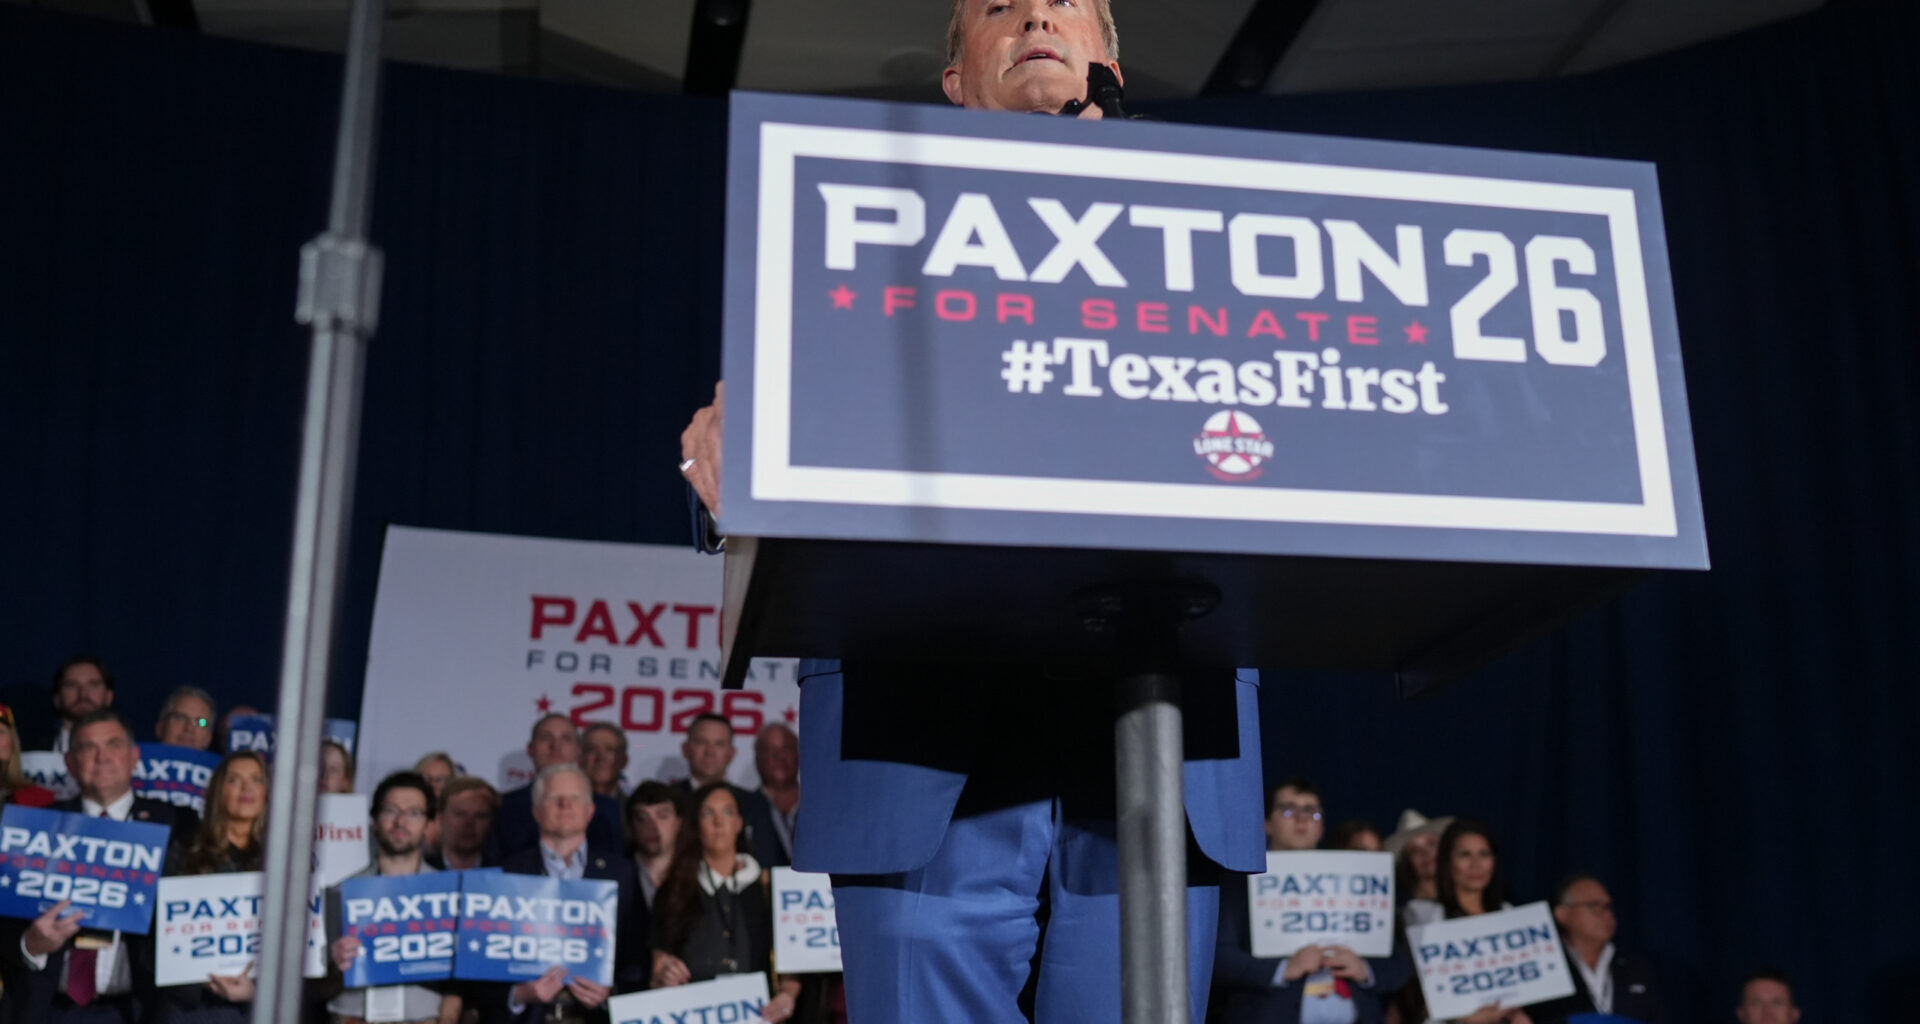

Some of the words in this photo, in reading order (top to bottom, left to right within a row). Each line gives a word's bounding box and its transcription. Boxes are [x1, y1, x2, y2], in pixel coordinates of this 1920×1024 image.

[818, 183, 1429, 306] PAXTON
[1443, 229, 1607, 367] 26
[883, 287, 1034, 325] FOR
[1081, 299, 1379, 345] SENATE
[1001, 337, 1448, 415] #TexasFirst
[1193, 436, 1233, 455] LONE
[1234, 436, 1274, 458] STAR
[530, 595, 722, 649] PAXT
[526, 650, 612, 675] FOR
[569, 683, 765, 735] 2026
[132, 758, 213, 788] AXTO
[0, 826, 162, 872] PAXTON
[16, 870, 128, 908] 2026
[57, 861, 156, 885] SENATE
[1257, 873, 1389, 895] PAXTON
[346, 892, 460, 924] PAXT
[465, 892, 608, 925] PAXTON
[1281, 911, 1372, 933] 2026
[165, 923, 212, 934] FOR
[464, 919, 510, 932] FOR
[191, 933, 262, 958] 202
[373, 931, 454, 963] 202
[485, 933, 588, 963] 2026
[1419, 924, 1552, 963] PAXTON
[1450, 961, 1541, 995] 2026
